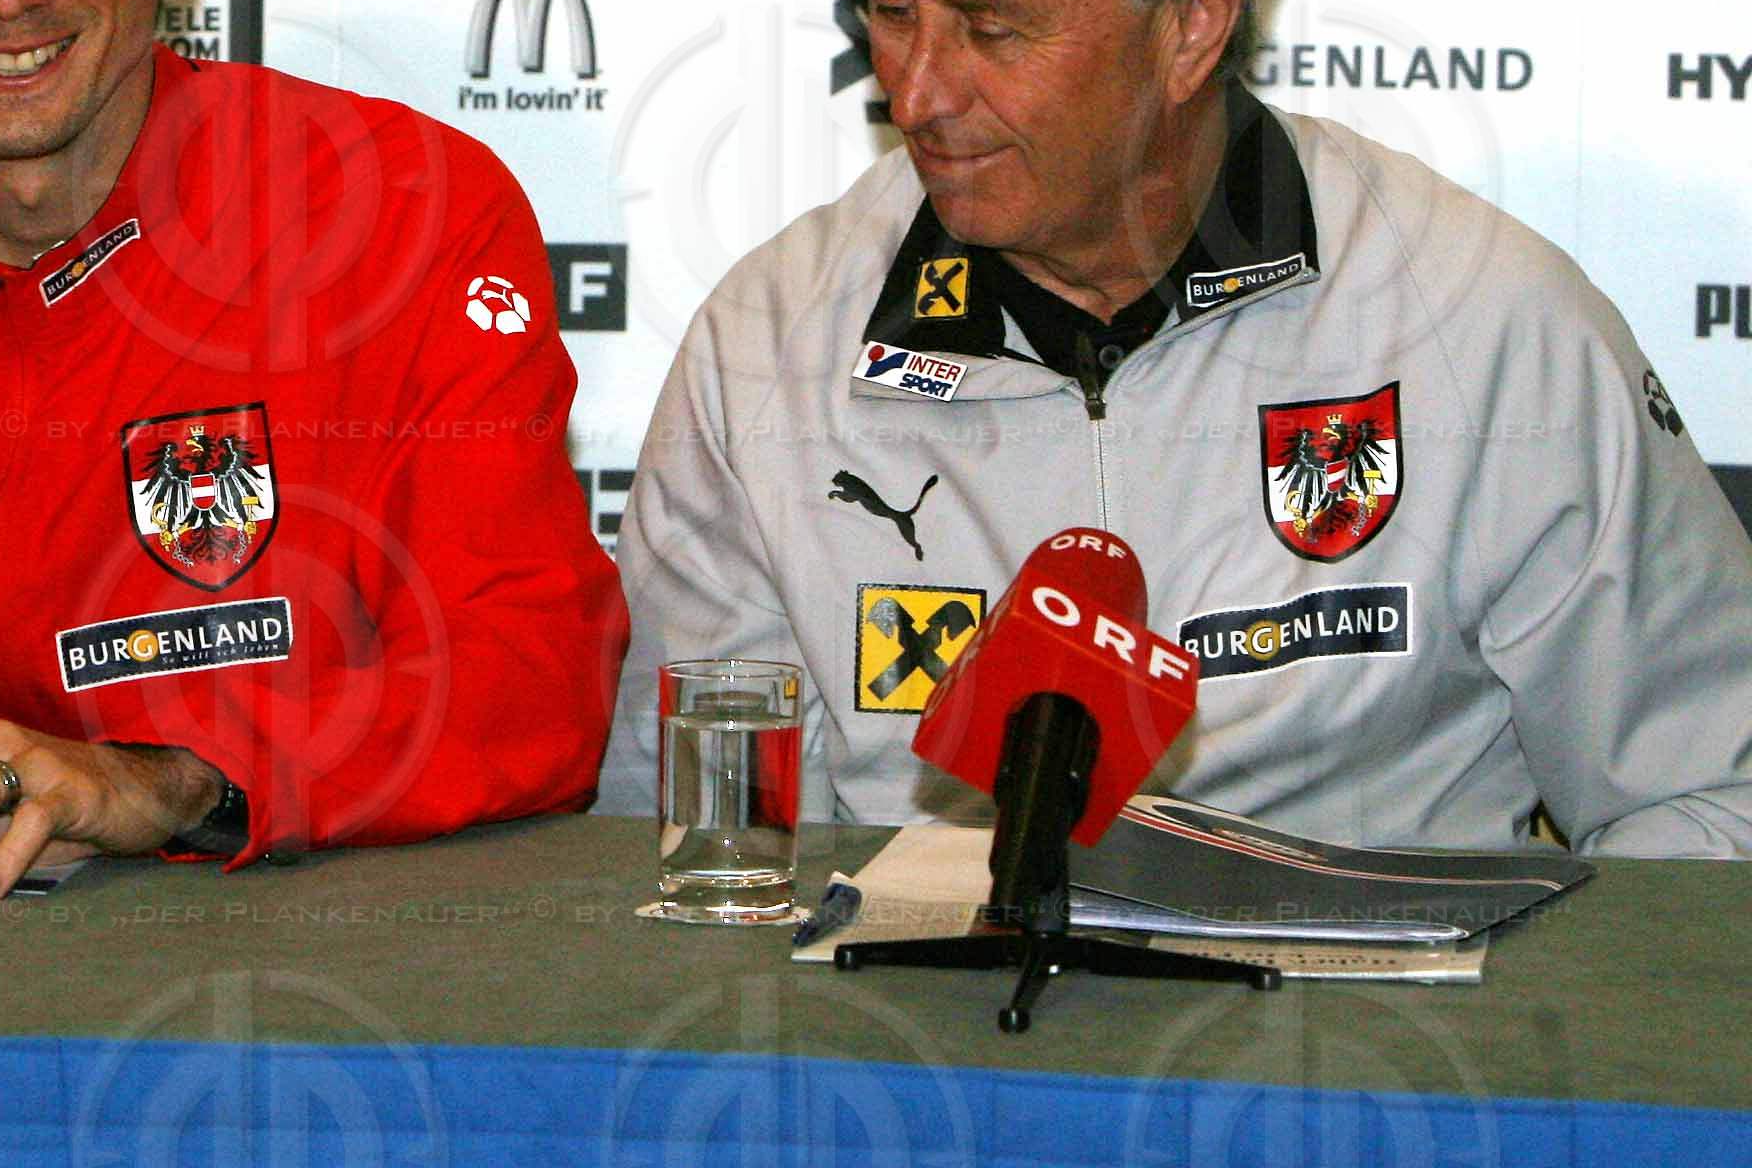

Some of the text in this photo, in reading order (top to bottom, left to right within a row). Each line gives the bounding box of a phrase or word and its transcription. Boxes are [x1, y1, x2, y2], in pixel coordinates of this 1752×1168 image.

[155, 6, 221, 31] ELE
[1249, 44, 1536, 91] GENLAND
[458, 87, 498, 110] i'm
[506, 87, 580, 111] lovin'
[907, 354, 961, 382] INTER
[898, 372, 953, 398] SPORT
[1049, 534, 1127, 560] ORF
[67, 617, 283, 672] BURGENLAND
[1031, 585, 1189, 681] ORF
[1183, 605, 1400, 660] BURGENLAND
